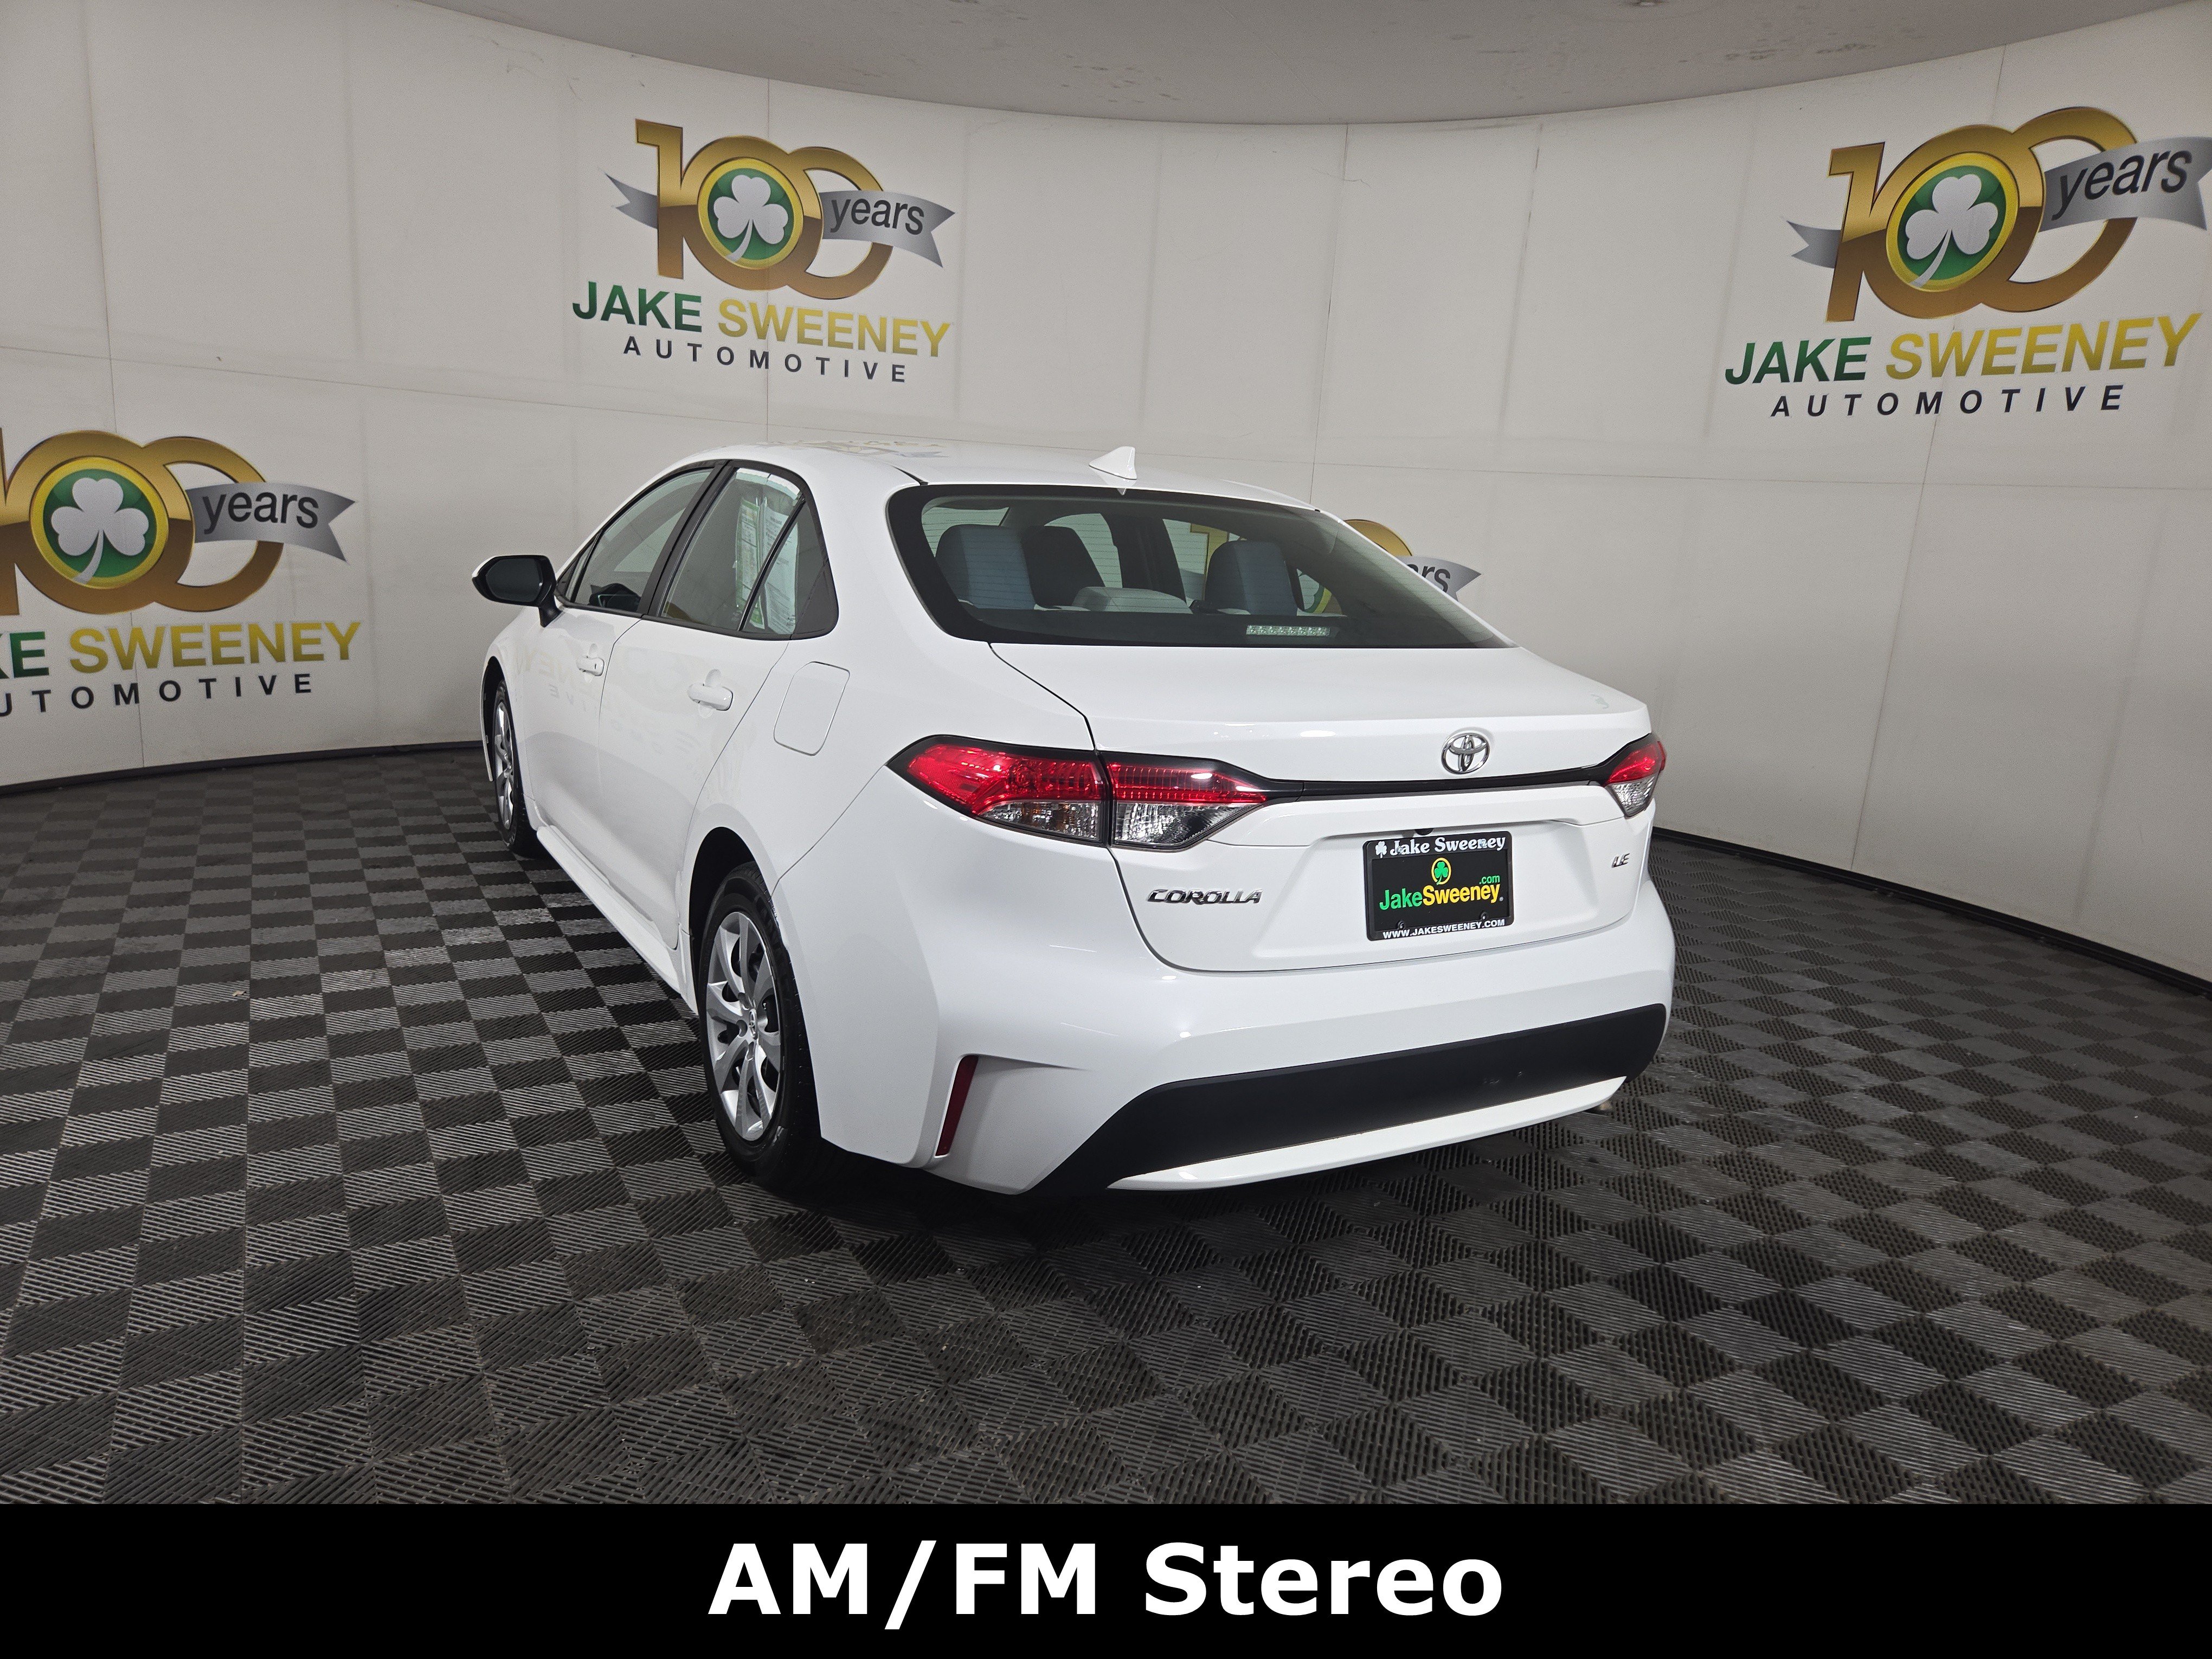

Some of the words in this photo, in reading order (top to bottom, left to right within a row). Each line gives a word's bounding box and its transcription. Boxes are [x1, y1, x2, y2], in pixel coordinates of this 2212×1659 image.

[2051, 150, 2192, 219] years
[829, 197, 925, 235] years
[573, 281, 702, 332] JAKE
[718, 298, 950, 357] SWEENEY
[623, 336, 906, 383] AUTOMOTIVE
[1725, 336, 1872, 384] JAKE
[1885, 313, 2202, 380] SWEENEY
[1770, 385, 2124, 417] AUTOMOTIVE
[202, 491, 319, 535] years
[69, 621, 361, 673] SWEENEY
[1390, 840, 1430, 856] Jake
[1434, 837, 1506, 851] Sweeney
[1611, 853, 1630, 868] LE
[1146, 889, 1263, 905] COROLLA
[1382, 918, 1506, 939] WWW.JAKESWEENEY.COM
